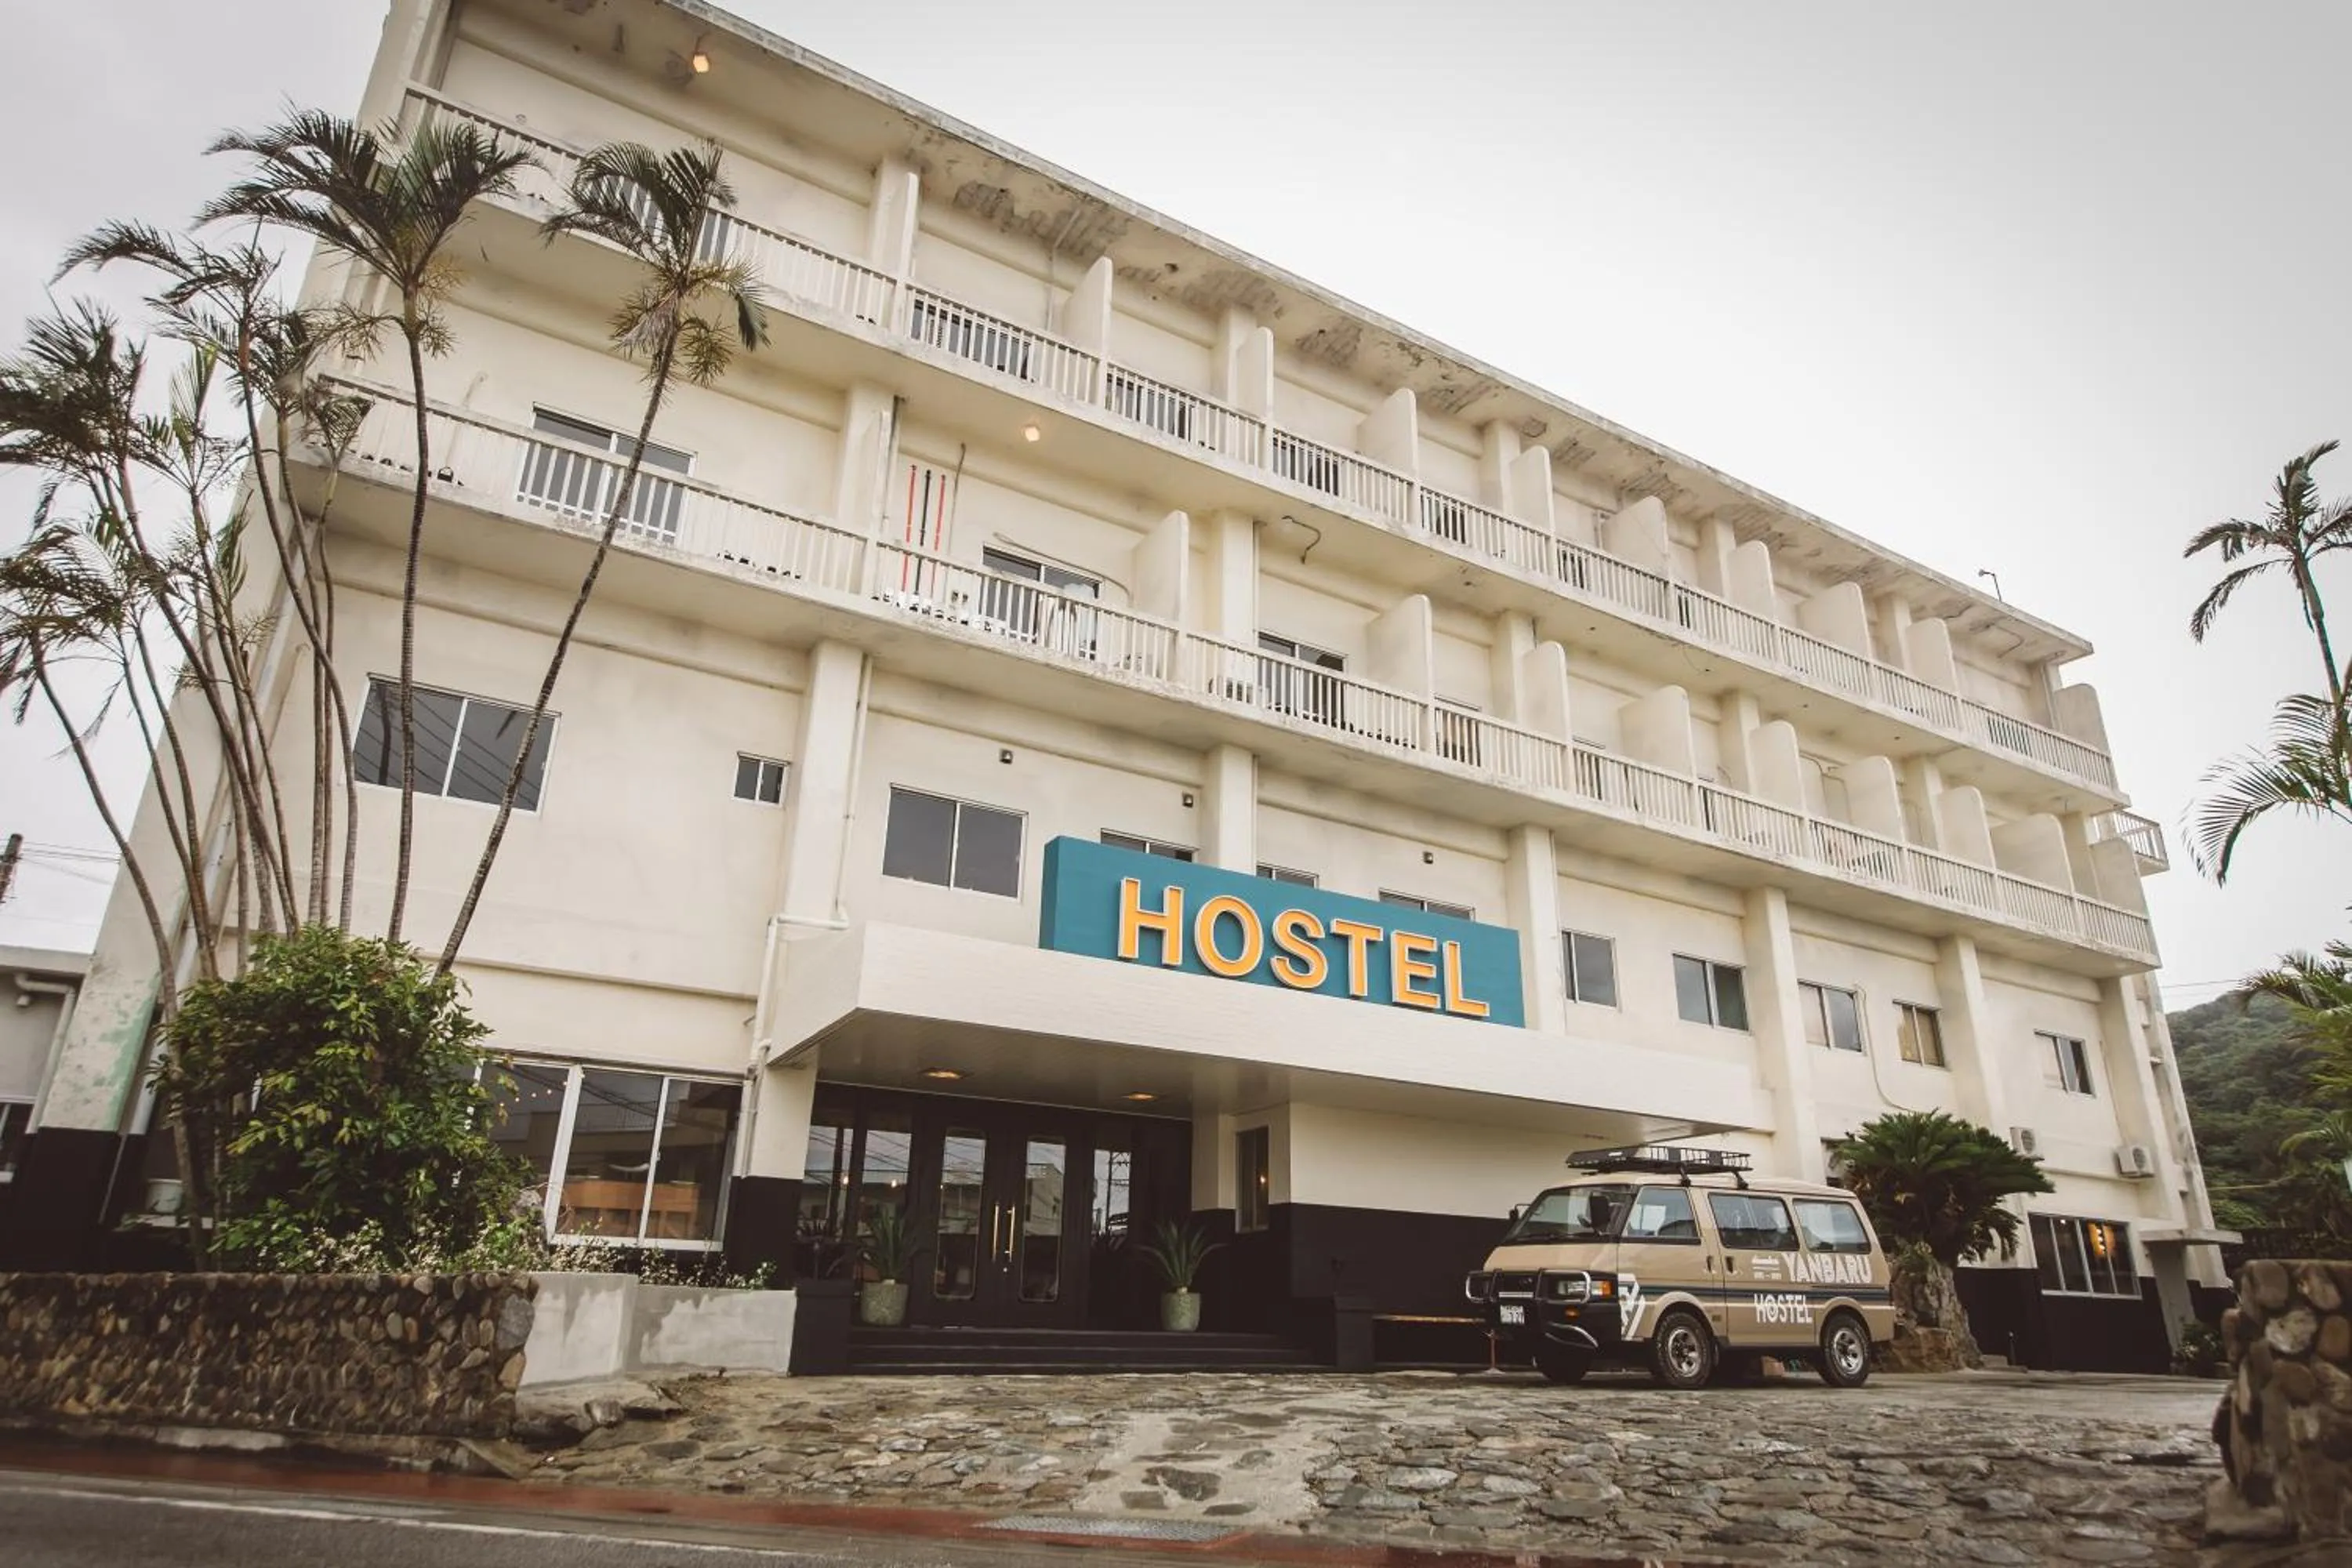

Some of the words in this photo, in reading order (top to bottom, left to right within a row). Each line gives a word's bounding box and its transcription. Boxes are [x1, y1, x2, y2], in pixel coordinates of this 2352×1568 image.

[1118, 877, 1490, 1017] HOSTEL
[1781, 1252, 1872, 1283] YANBARU
[1754, 1294, 1813, 1323] HOSTEL
